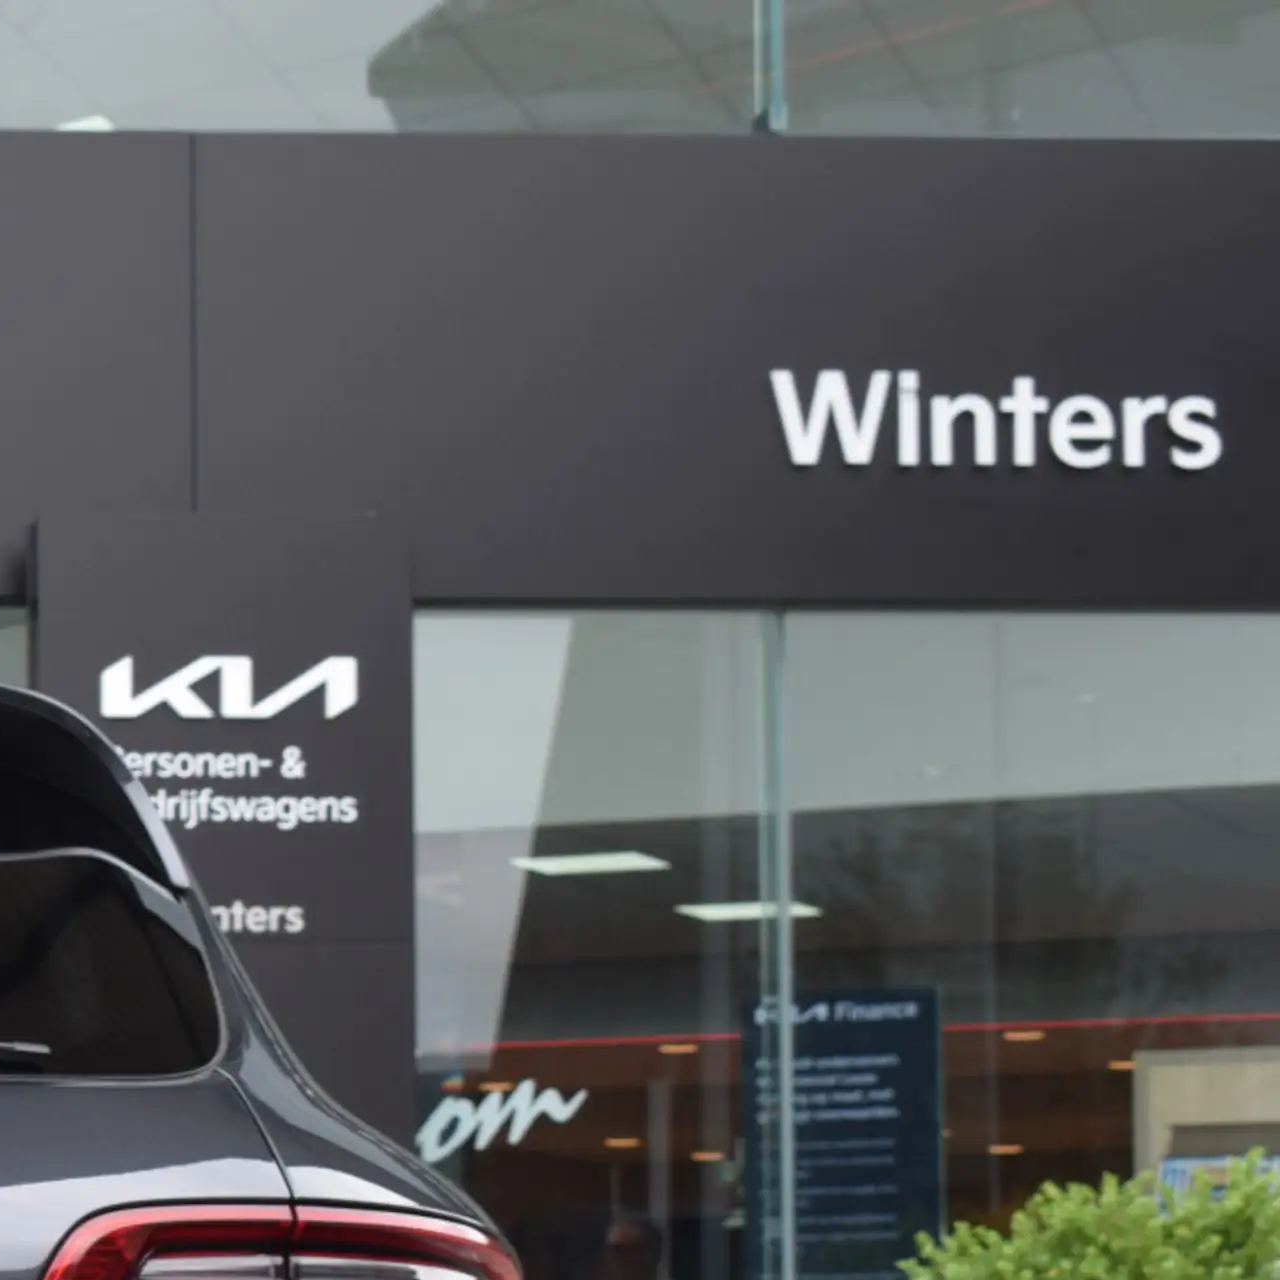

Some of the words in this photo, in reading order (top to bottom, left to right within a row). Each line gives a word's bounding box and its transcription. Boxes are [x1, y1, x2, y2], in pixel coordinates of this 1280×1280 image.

[769, 369, 1223, 470] Winters
[100, 654, 358, 720] KIA
[116, 746, 273, 779] ersonen-
[280, 745, 307, 779] &
[149, 787, 359, 830] drijfswagens
[209, 899, 306, 934] nters
